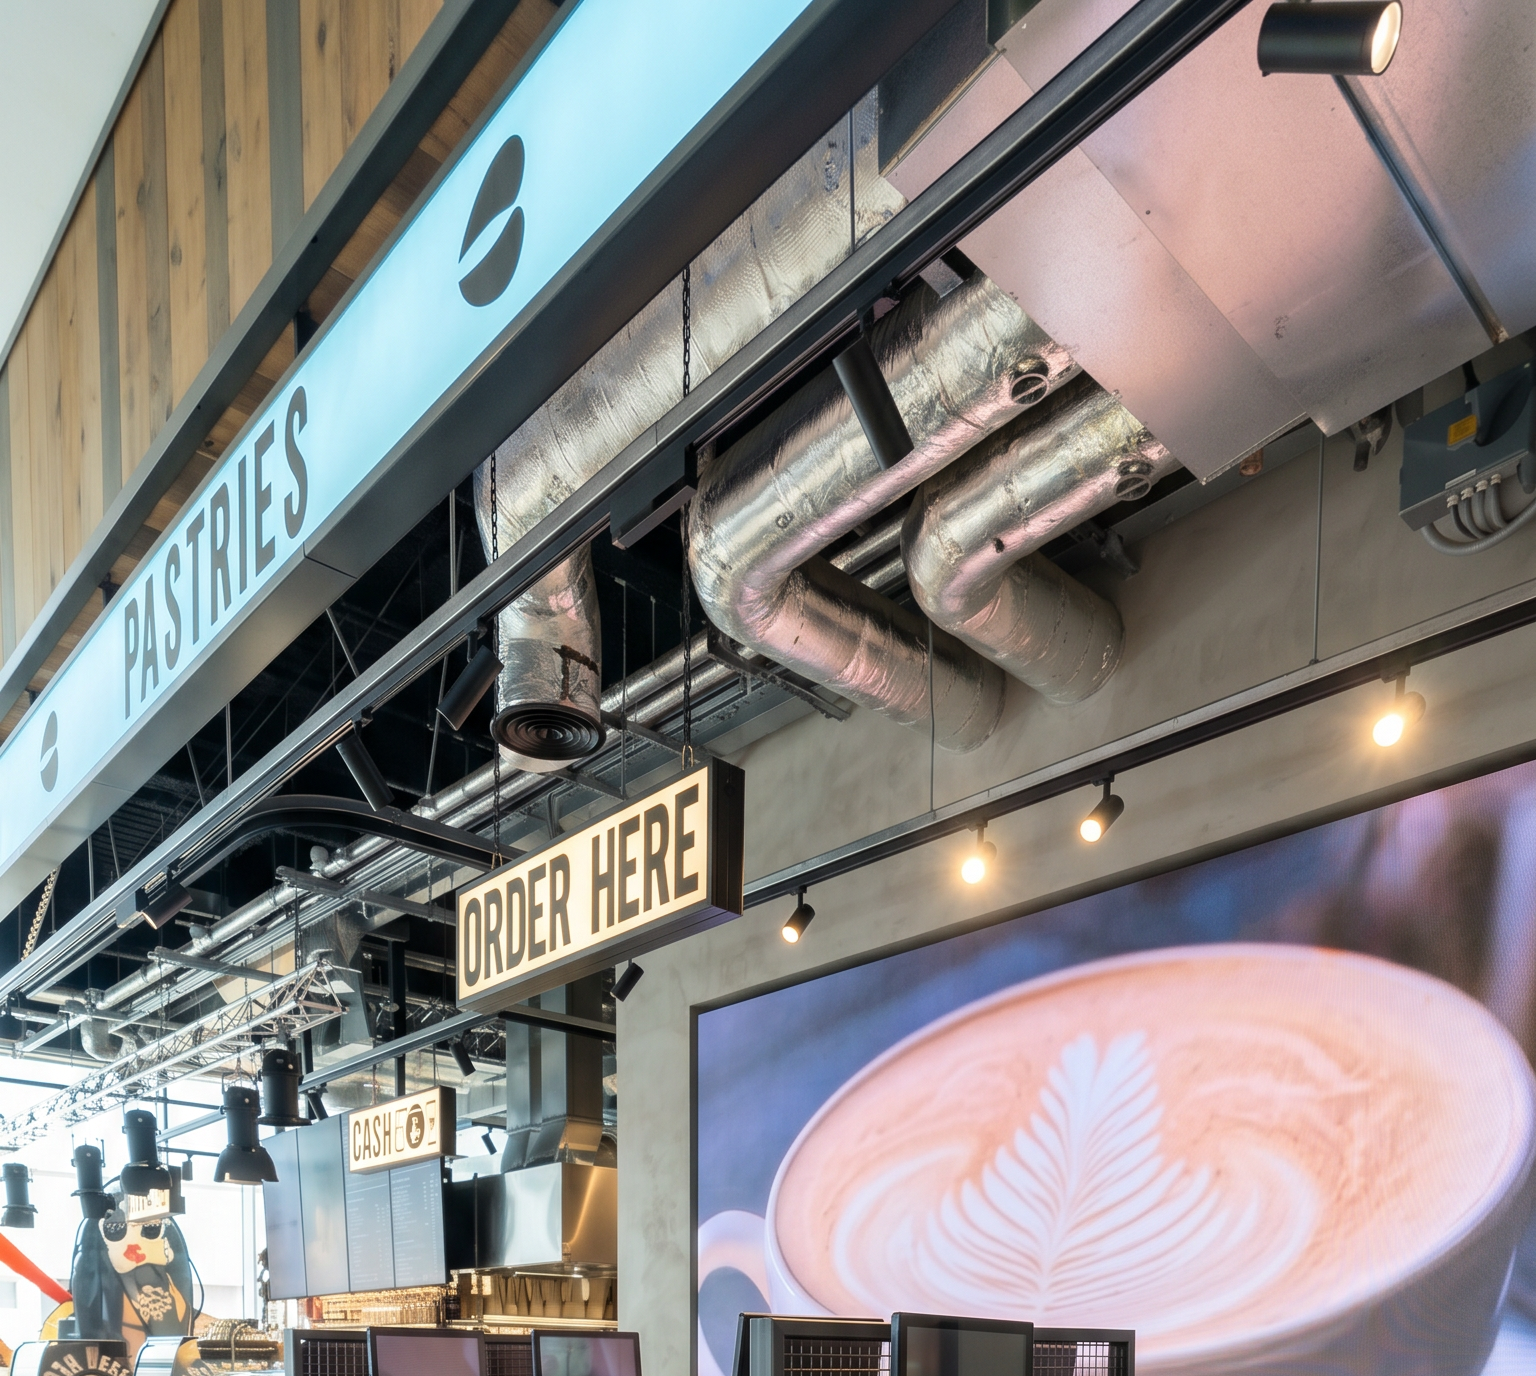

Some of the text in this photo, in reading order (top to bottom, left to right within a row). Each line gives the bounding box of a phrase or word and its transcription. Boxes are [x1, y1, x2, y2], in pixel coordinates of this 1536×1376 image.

[123, 385, 308, 720] PASTRIES
[463, 783, 699, 987] ORDER HERE
[353, 1111, 391, 1162] CASH
